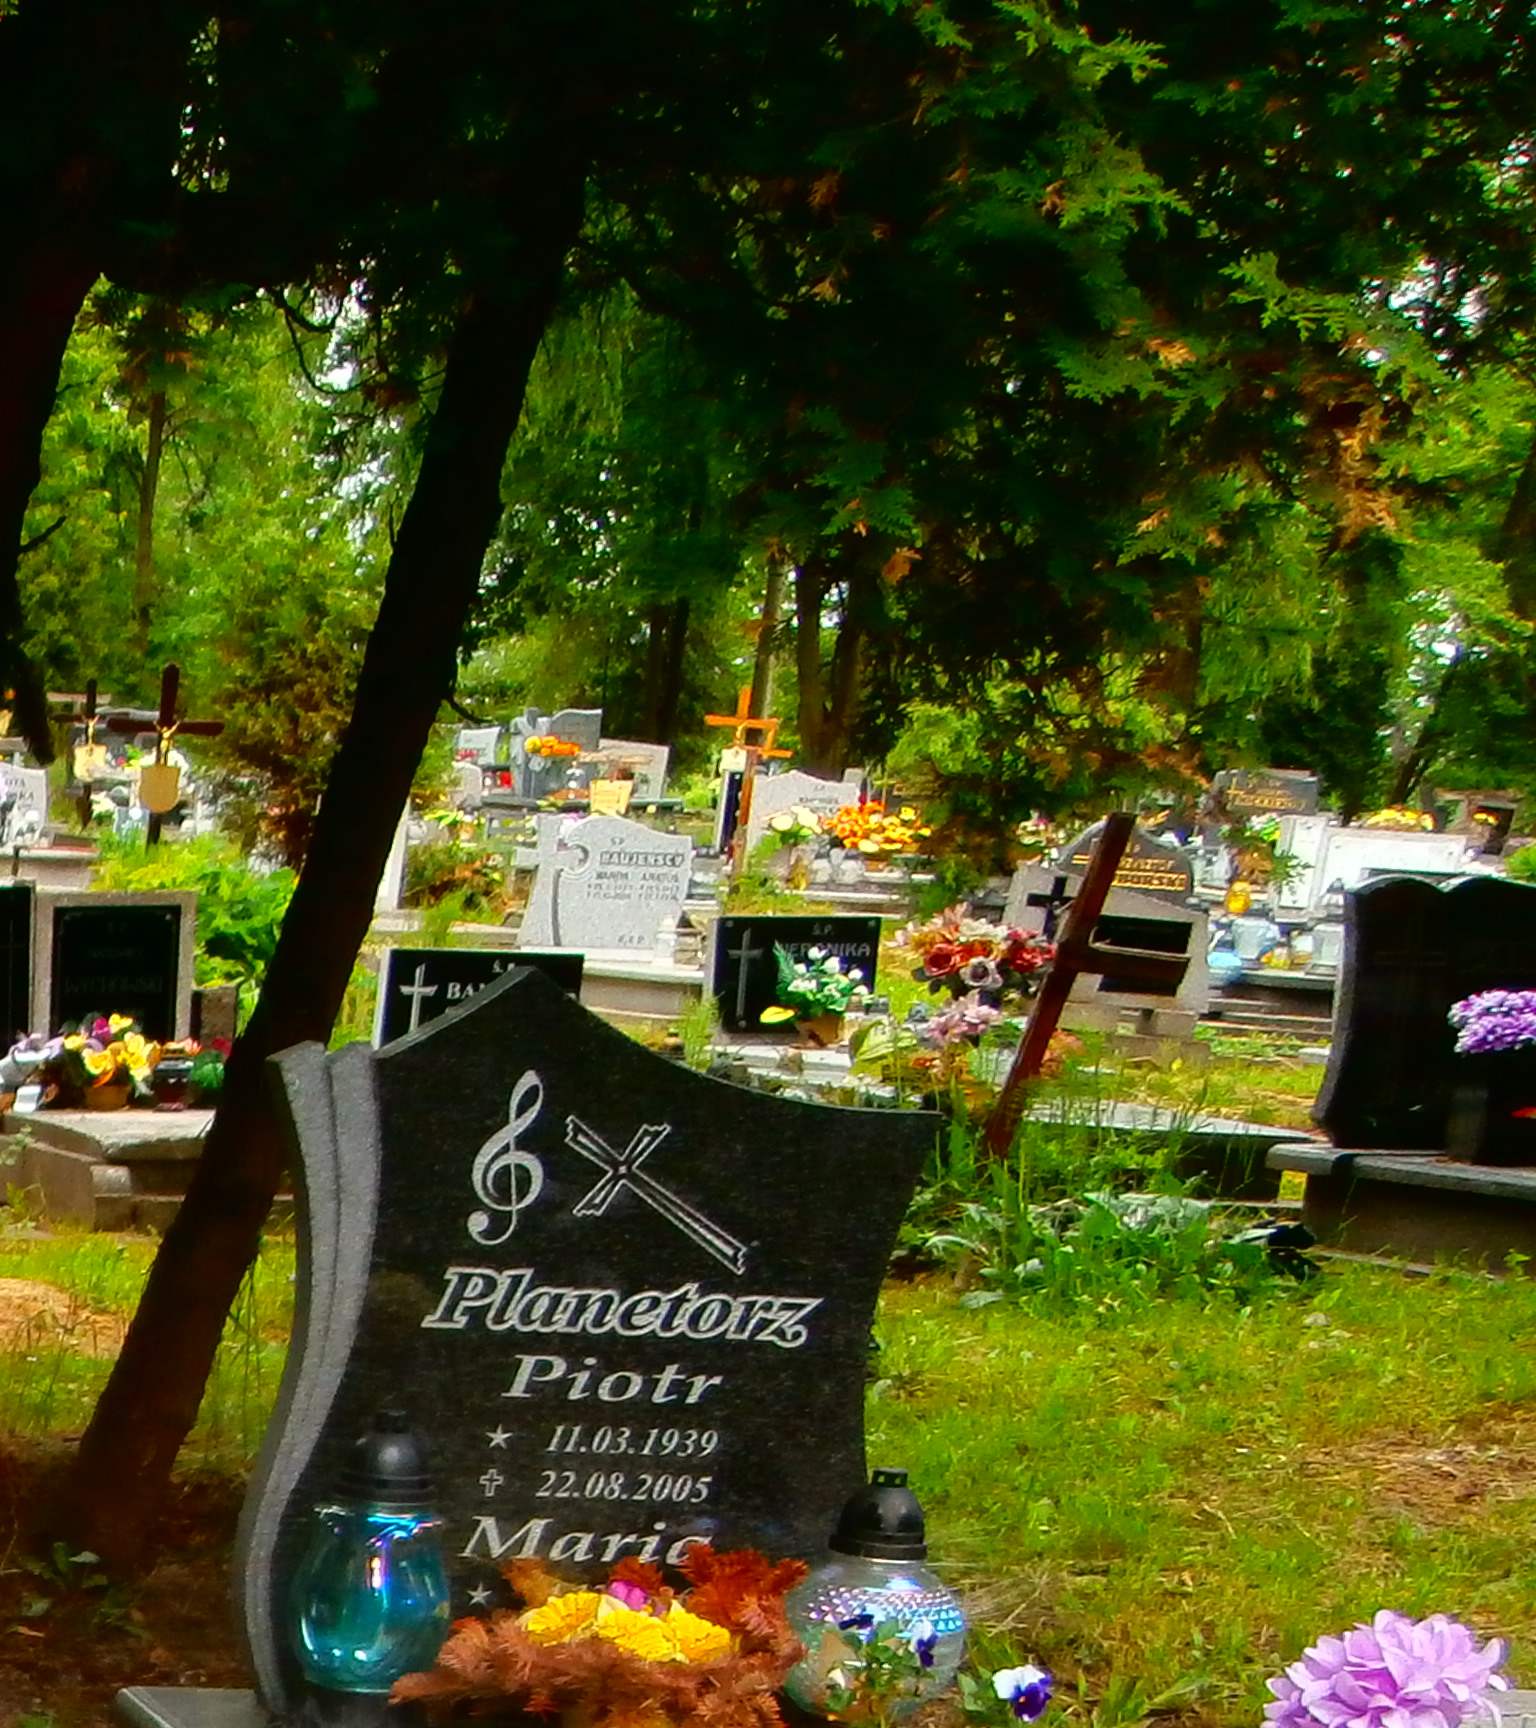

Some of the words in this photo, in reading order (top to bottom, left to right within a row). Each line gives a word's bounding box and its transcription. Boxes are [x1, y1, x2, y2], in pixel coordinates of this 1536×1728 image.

[422, 1265, 824, 1348] Planetorz
[501, 1353, 724, 1404] Piotr
[545, 1424, 719, 1457] 11.03.1939
[534, 1471, 713, 1502] 22.08.2005
